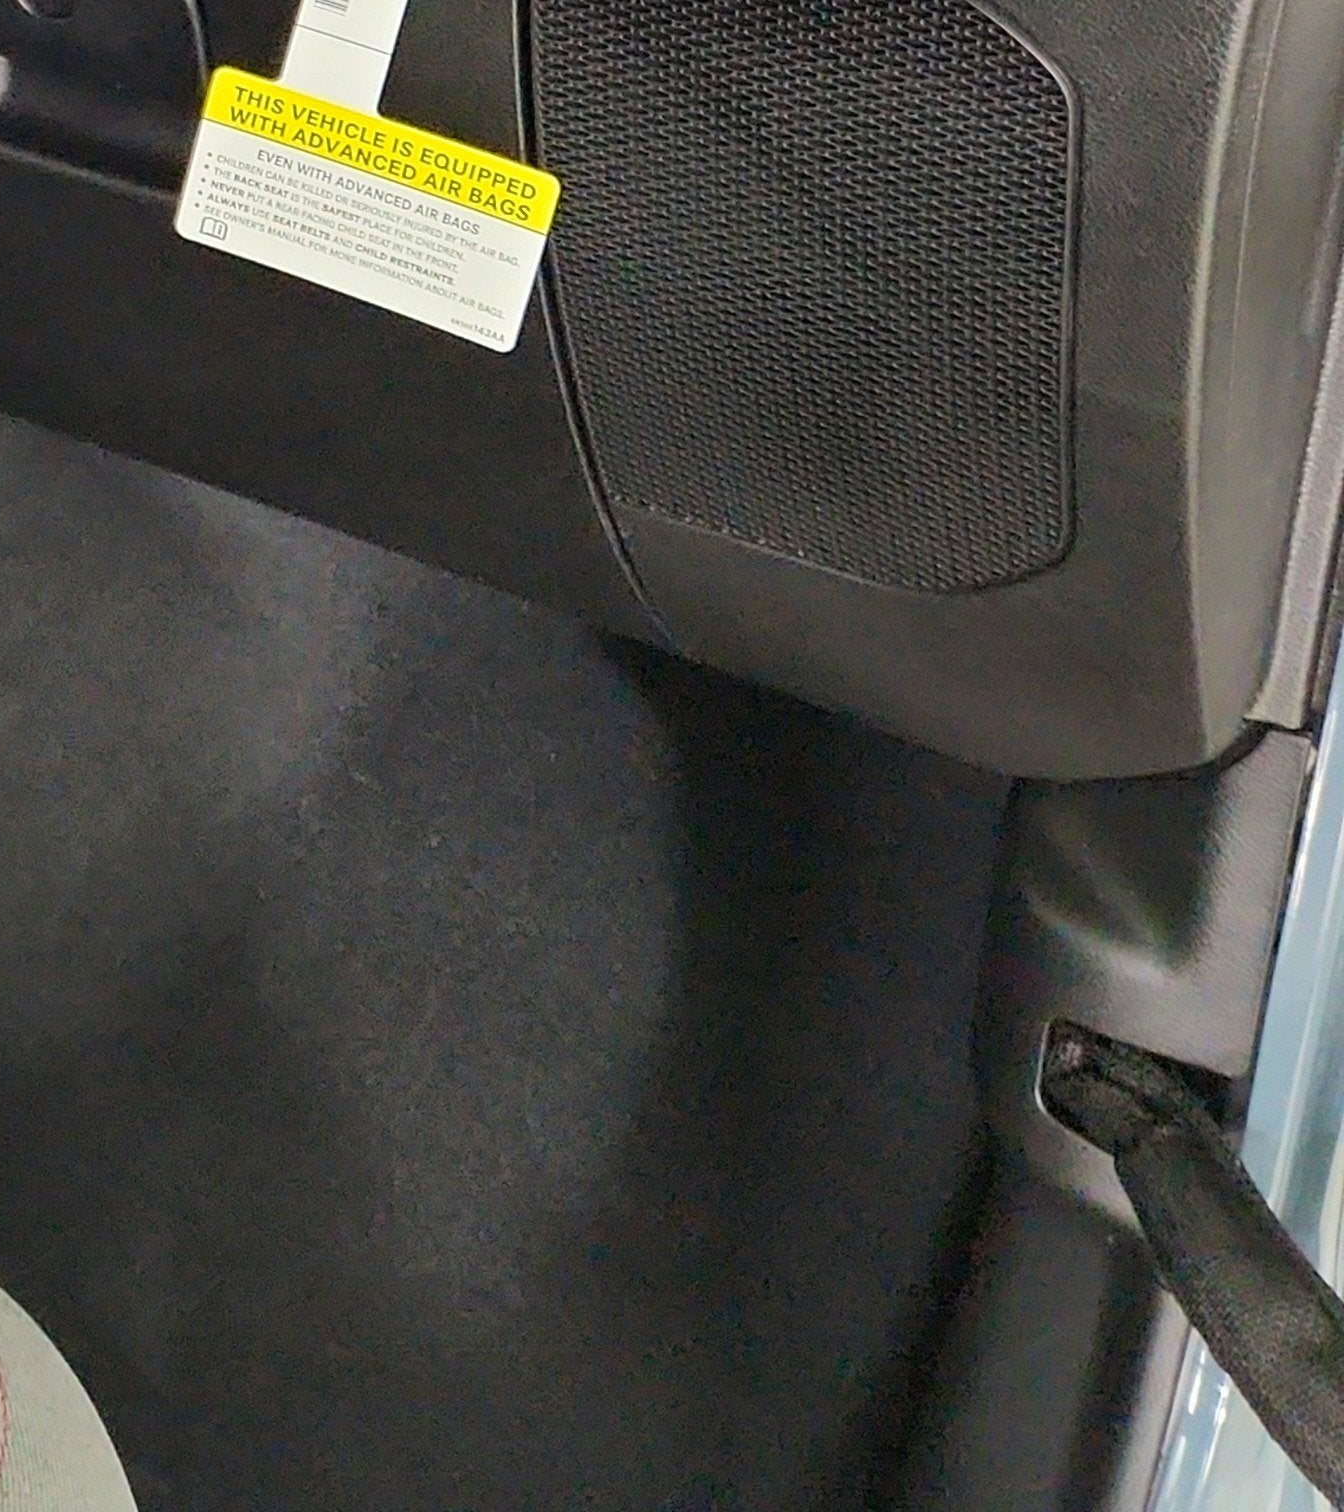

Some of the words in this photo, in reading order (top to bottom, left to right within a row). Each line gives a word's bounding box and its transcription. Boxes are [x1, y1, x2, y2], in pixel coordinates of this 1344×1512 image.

[230, 105, 286, 137] WITH
[291, 127, 417, 180] ADVANCED
[422, 172, 462, 198] AIR
[467, 186, 530, 221] BAGS
[234, 85, 285, 114] THIS
[291, 103, 386, 149] VEHICLE
[391, 137, 414, 157] IS
[419, 147, 536, 199] EQUIPPED
[206, 192, 250, 213] ALWAYS
[272, 214, 298, 229] SEAT
[299, 223, 331, 241] BELTS
[354, 243, 388, 261] CHILD
[210, 179, 245, 198] NEVER
[265, 198, 273, 207] A
[213, 166, 232, 179] THE
[233, 173, 262, 189] BACK
[263, 183, 289, 198] SEAT
[301, 195, 320, 210] THE
[321, 203, 361, 223] SAFEST
[361, 216, 392, 235] PLACE
[393, 227, 414, 243] FOR
[216, 154, 264, 176] CHILDREN
[264, 169, 285, 184] CAN
[459, 237, 478, 252] THE
[479, 245, 496, 258] AIR
[256, 148, 293, 170] EVEN
[296, 161, 332, 184] WITH
[334, 175, 412, 210] ADVANCED
[413, 203, 438, 221] AIR
[441, 211, 480, 235] BAGS
